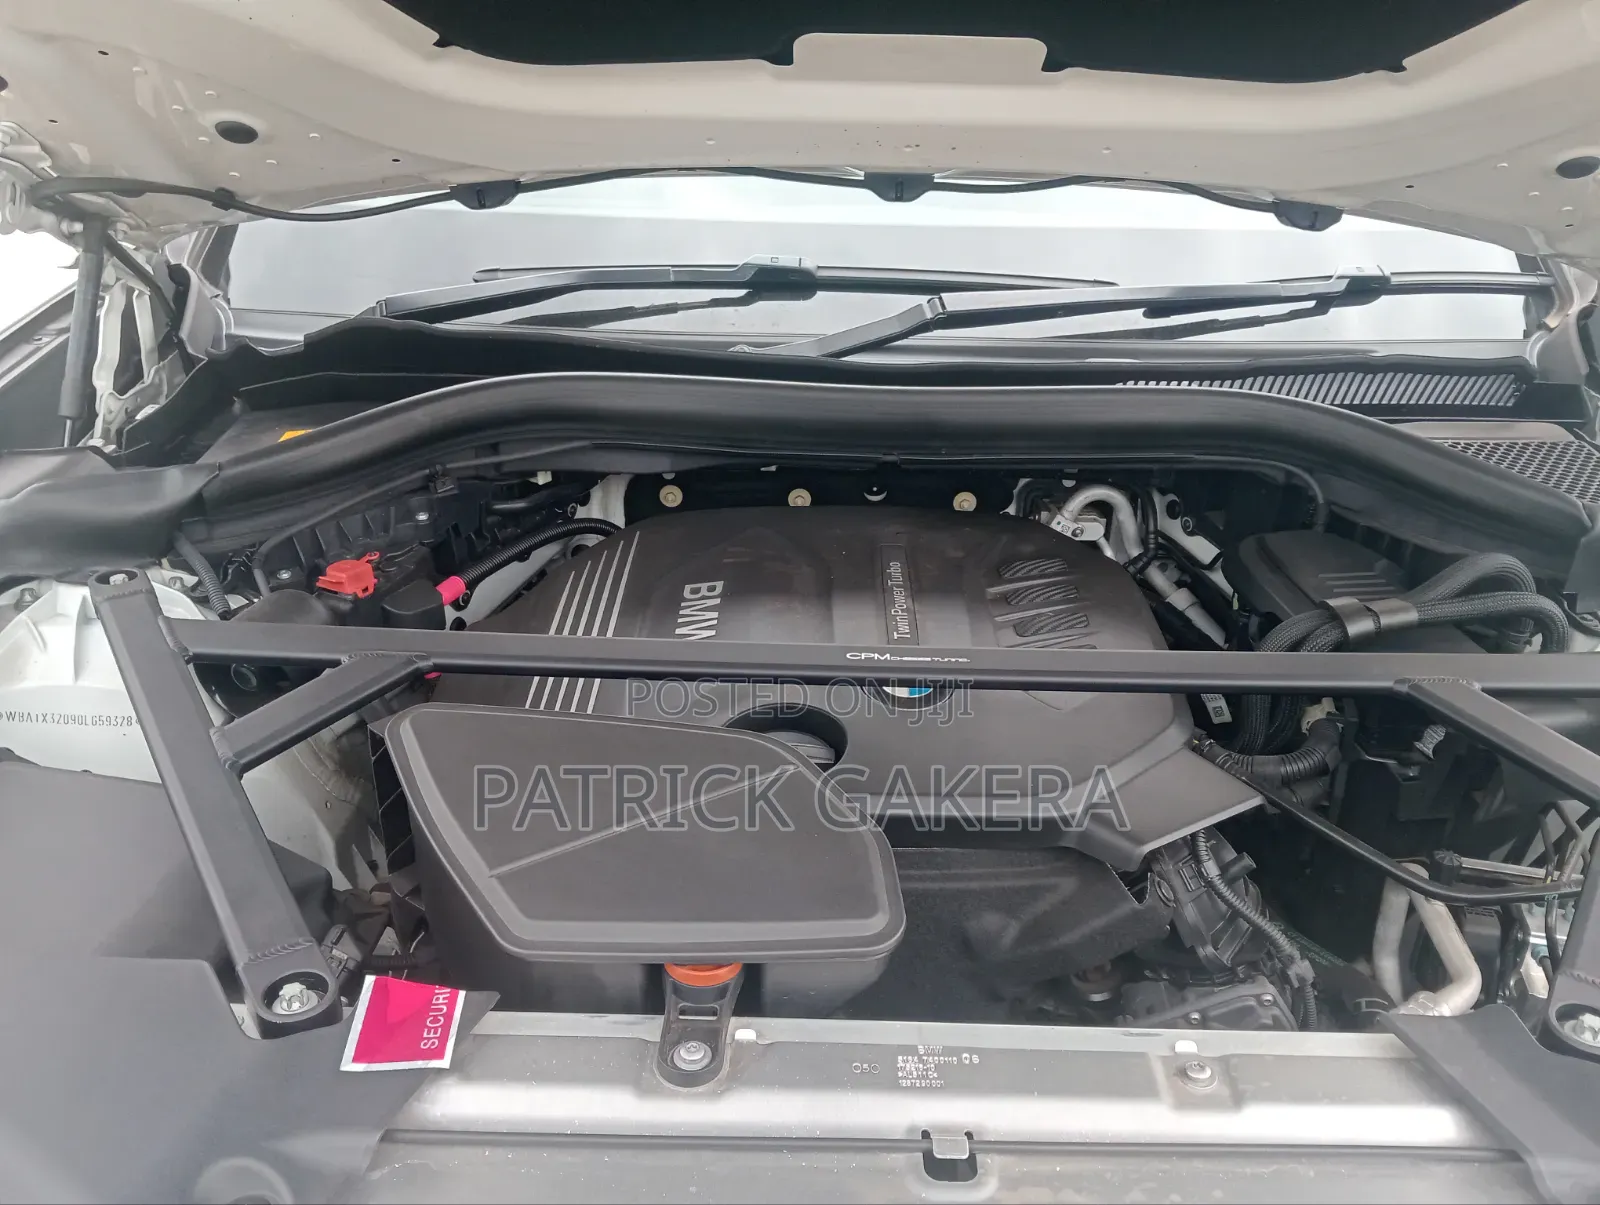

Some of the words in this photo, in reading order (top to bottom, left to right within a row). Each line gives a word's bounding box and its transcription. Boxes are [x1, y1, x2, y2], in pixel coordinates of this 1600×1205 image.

[886, 561, 904, 586] Turbo
[675, 580, 724, 640] BMW
[890, 587, 911, 640] TwinPower
[846, 652, 891, 661] CPM
[420, 985, 451, 1049] SECURI
[917, 1045, 943, 1054] BMW
